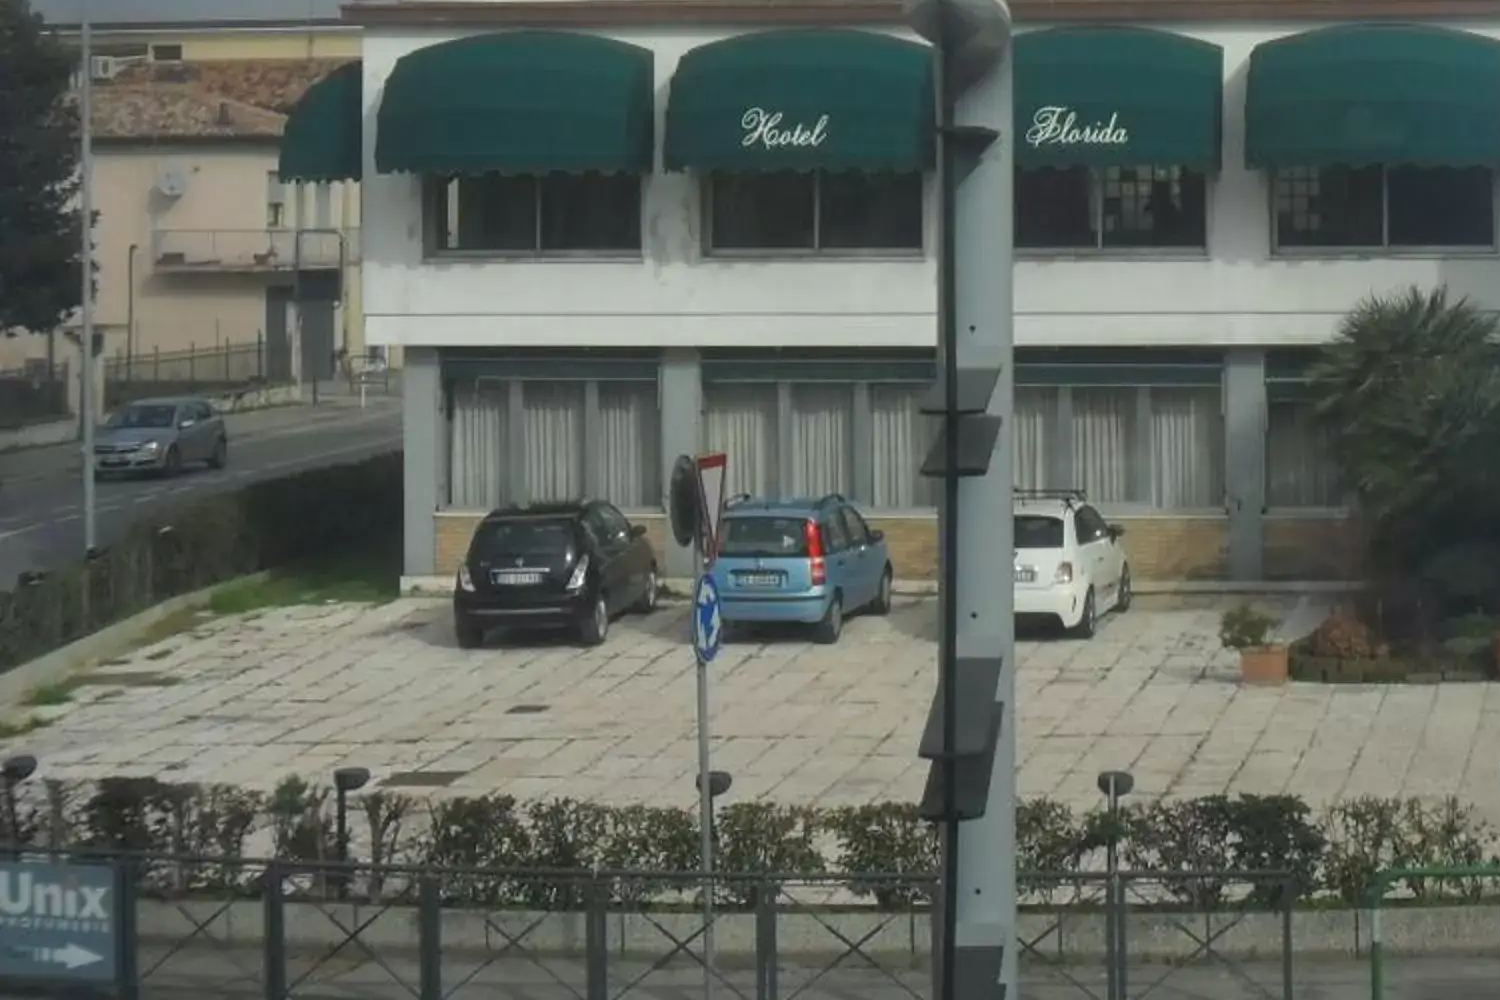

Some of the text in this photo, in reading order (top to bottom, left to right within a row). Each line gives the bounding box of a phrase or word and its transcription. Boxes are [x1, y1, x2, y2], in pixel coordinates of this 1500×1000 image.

[742, 106, 1128, 150] Hotel Florida
[0, 869, 109, 919] Unix
